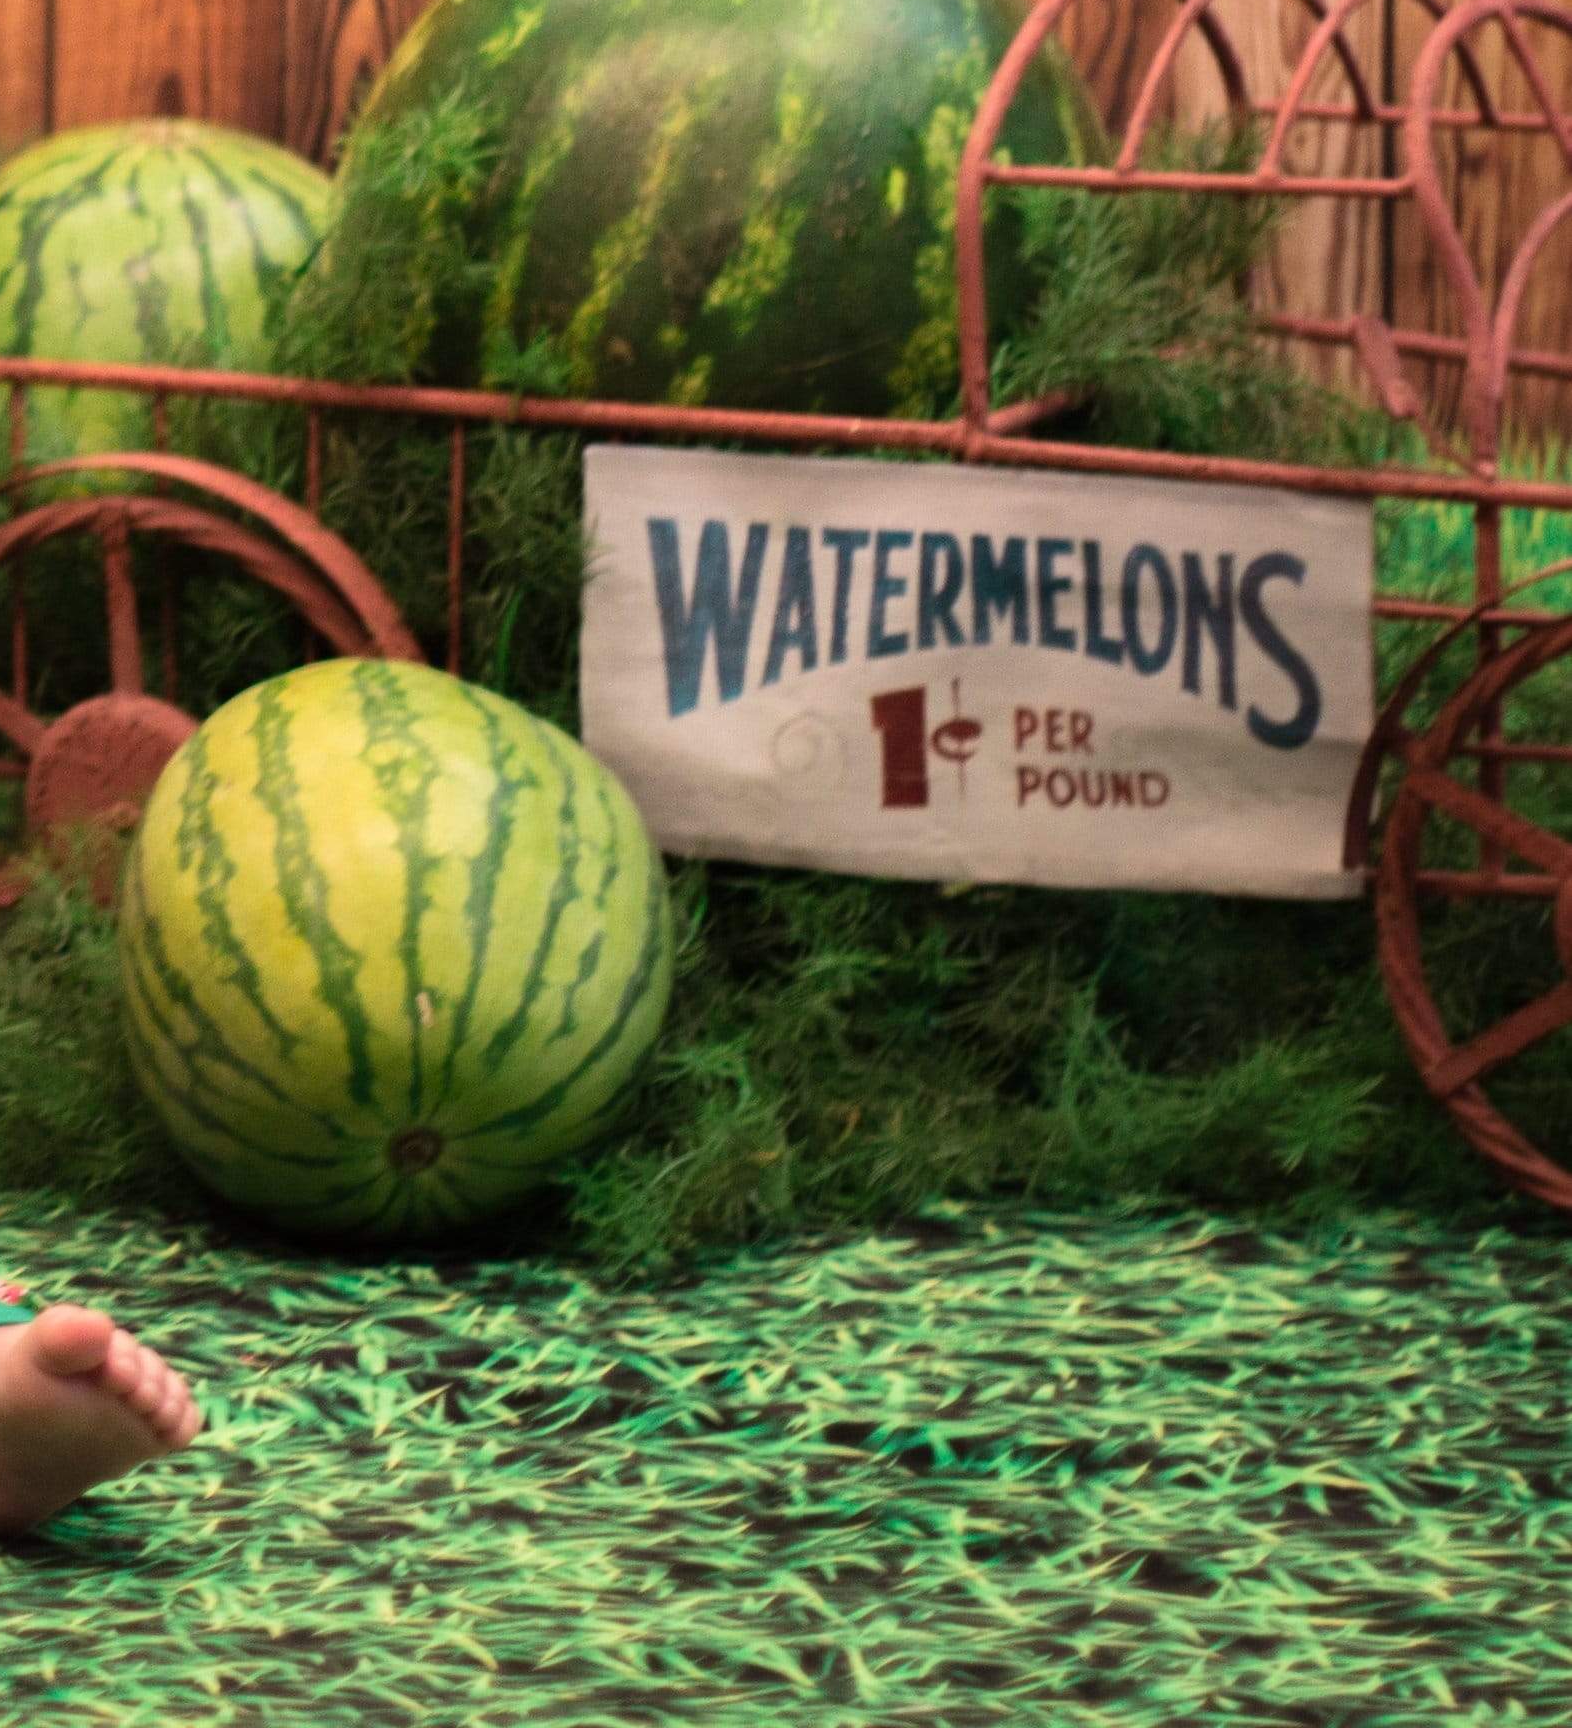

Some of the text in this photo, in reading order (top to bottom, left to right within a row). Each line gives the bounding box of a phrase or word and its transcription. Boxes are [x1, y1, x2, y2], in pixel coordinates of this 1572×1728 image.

[647, 516, 1323, 751] WATERMELONS
[1014, 705, 1096, 756] PER
[1015, 765, 1171, 809] POUND
